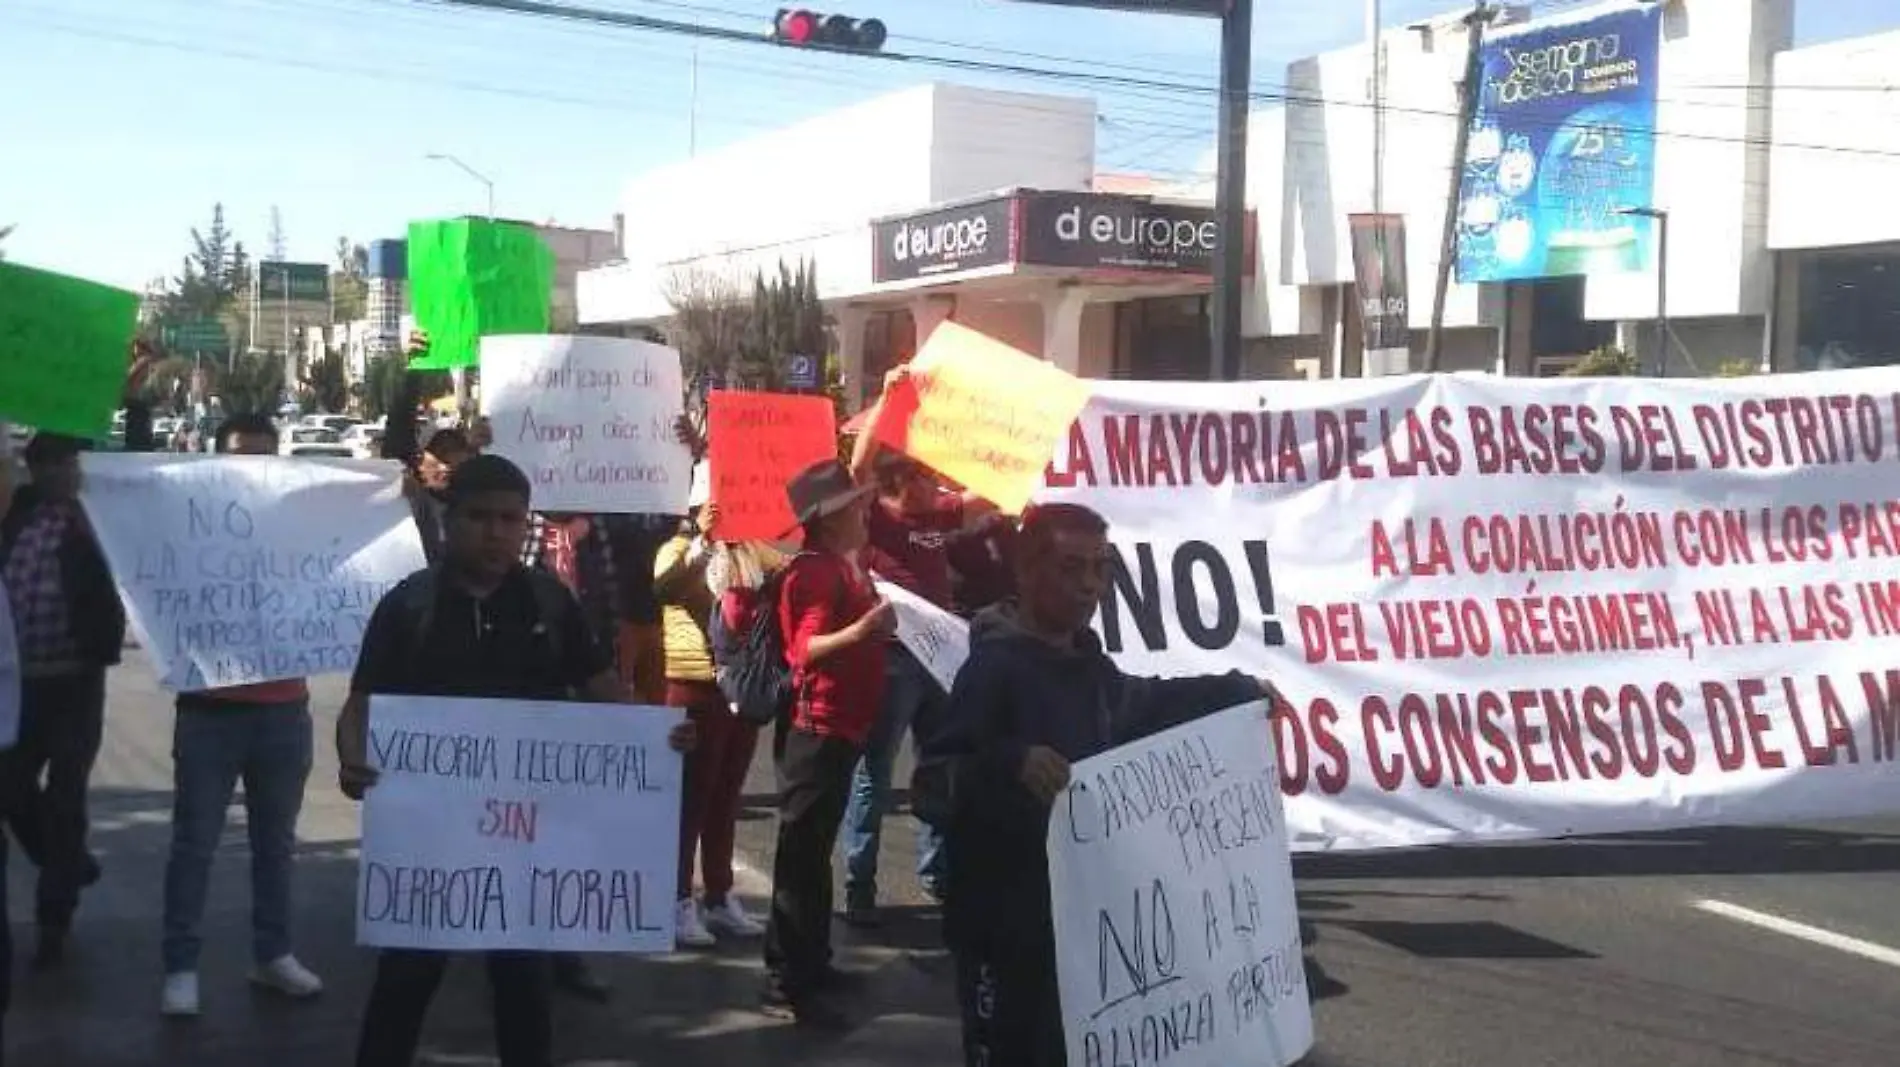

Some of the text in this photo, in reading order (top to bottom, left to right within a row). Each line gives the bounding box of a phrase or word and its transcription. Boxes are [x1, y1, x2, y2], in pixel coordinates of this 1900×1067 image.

[1044, 418, 1097, 488] LA
[1104, 397, 1306, 487] MAYORÍA
[1314, 406, 1374, 481] DE
[1379, 405, 1461, 478] LAS
[1468, 404, 1606, 475] BASES
[1610, 405, 1696, 472] DEL
[1693, 393, 1882, 469] DISTRITO
[188, 498, 254, 540] NO
[1370, 519, 1399, 578] A
[1405, 516, 1454, 576] LA
[1462, 494, 1667, 574] COALICIÓN
[1674, 508, 1754, 569] CON
[1761, 503, 1831, 562] LOS
[1100, 539, 1285, 653] NO!
[1298, 602, 1378, 663] DEL
[1379, 597, 1491, 660] VIEJO
[1497, 579, 1694, 660] RÉGIMEN,
[1694, 589, 1742, 646] NI
[1749, 586, 1779, 644] A
[1779, 582, 1853, 642] LAS
[369, 727, 498, 781] VICTORIA
[1268, 696, 1348, 796] OS
[1360, 681, 1697, 792] CONSENSOS
[1700, 678, 1786, 771] DE
[1783, 675, 1859, 766] LA
[478, 799, 538, 843] SIN
[1068, 735, 1227, 844] CARDONAL
[364, 861, 663, 933] DERROTA MORAL
[1098, 872, 1262, 1002] NO A LA
